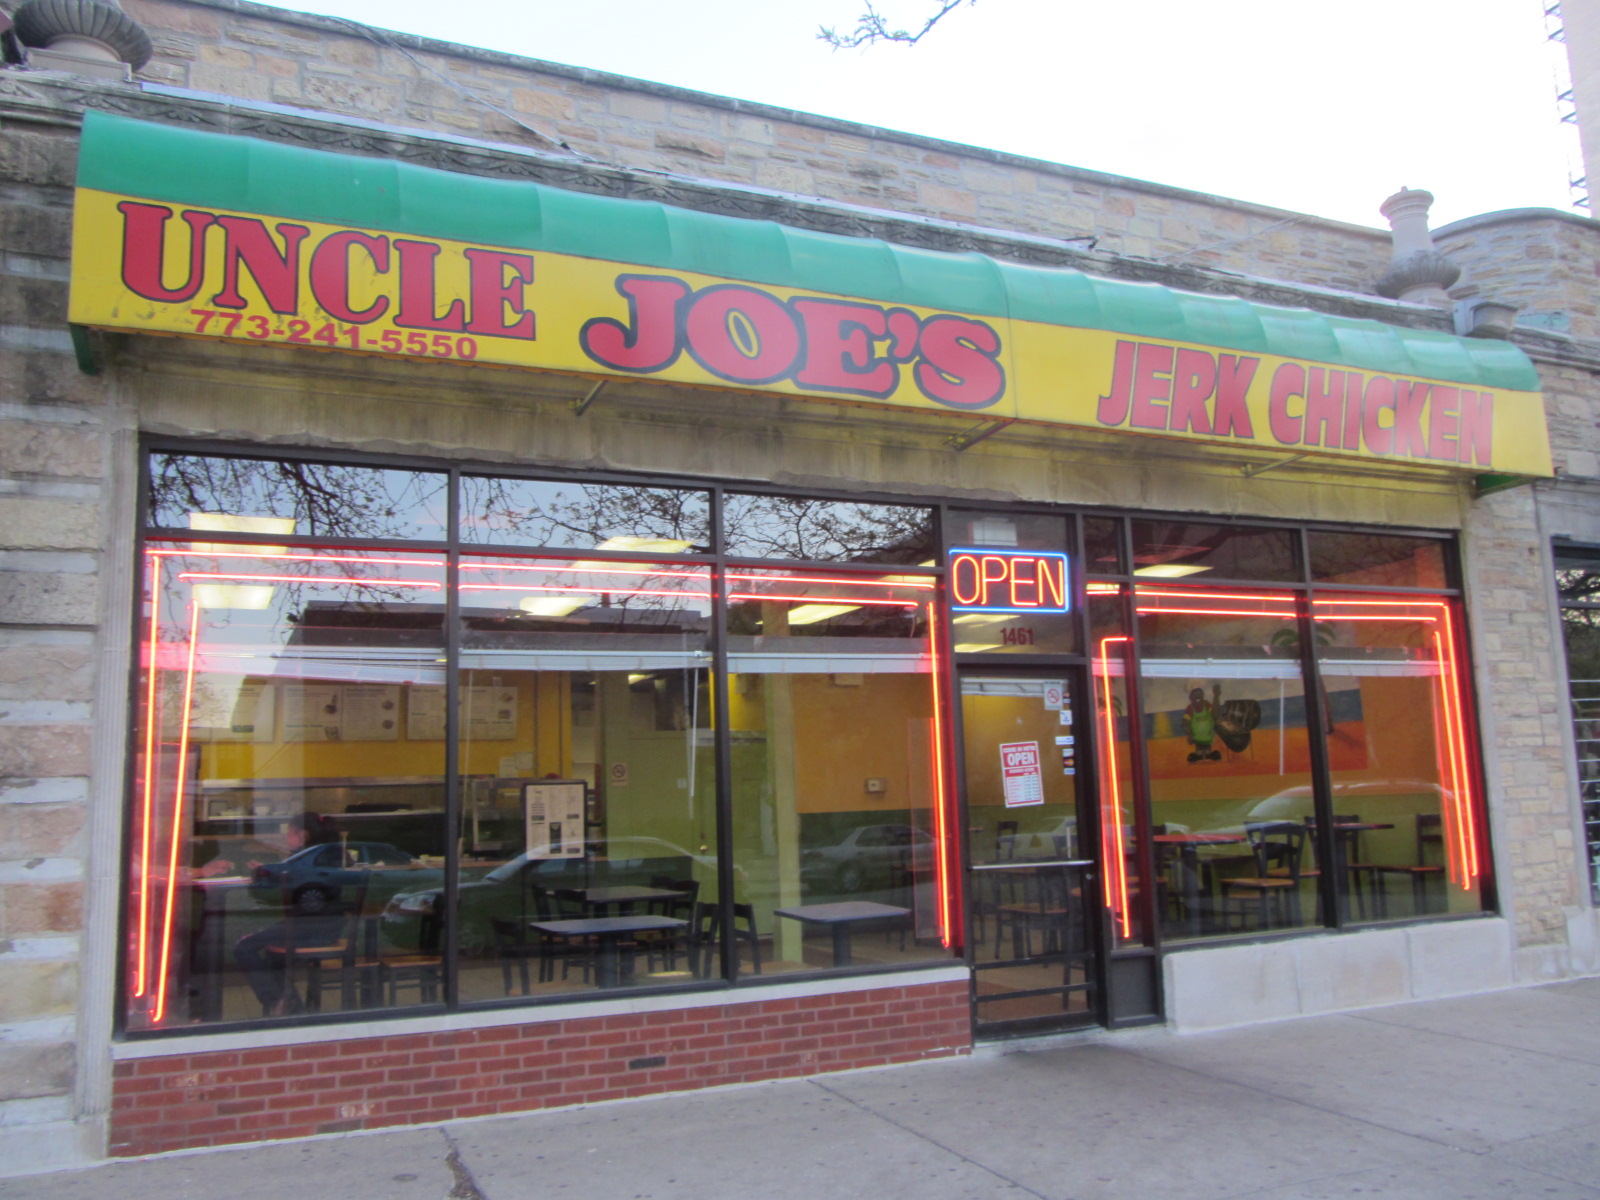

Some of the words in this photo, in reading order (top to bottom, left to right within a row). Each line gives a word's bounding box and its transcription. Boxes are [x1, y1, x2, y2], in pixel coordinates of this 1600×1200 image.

[117, 201, 536, 341] UNCLE
[579, 273, 1006, 409] JOE'S
[1097, 339, 1260, 439] JERK
[1269, 362, 1494, 466] CHICKEN
[191, 308, 478, 360] 773-241-5550
[952, 555, 1064, 606] OPEN
[1000, 627, 1034, 646] 1461
[1007, 751, 1035, 766] OPEN
